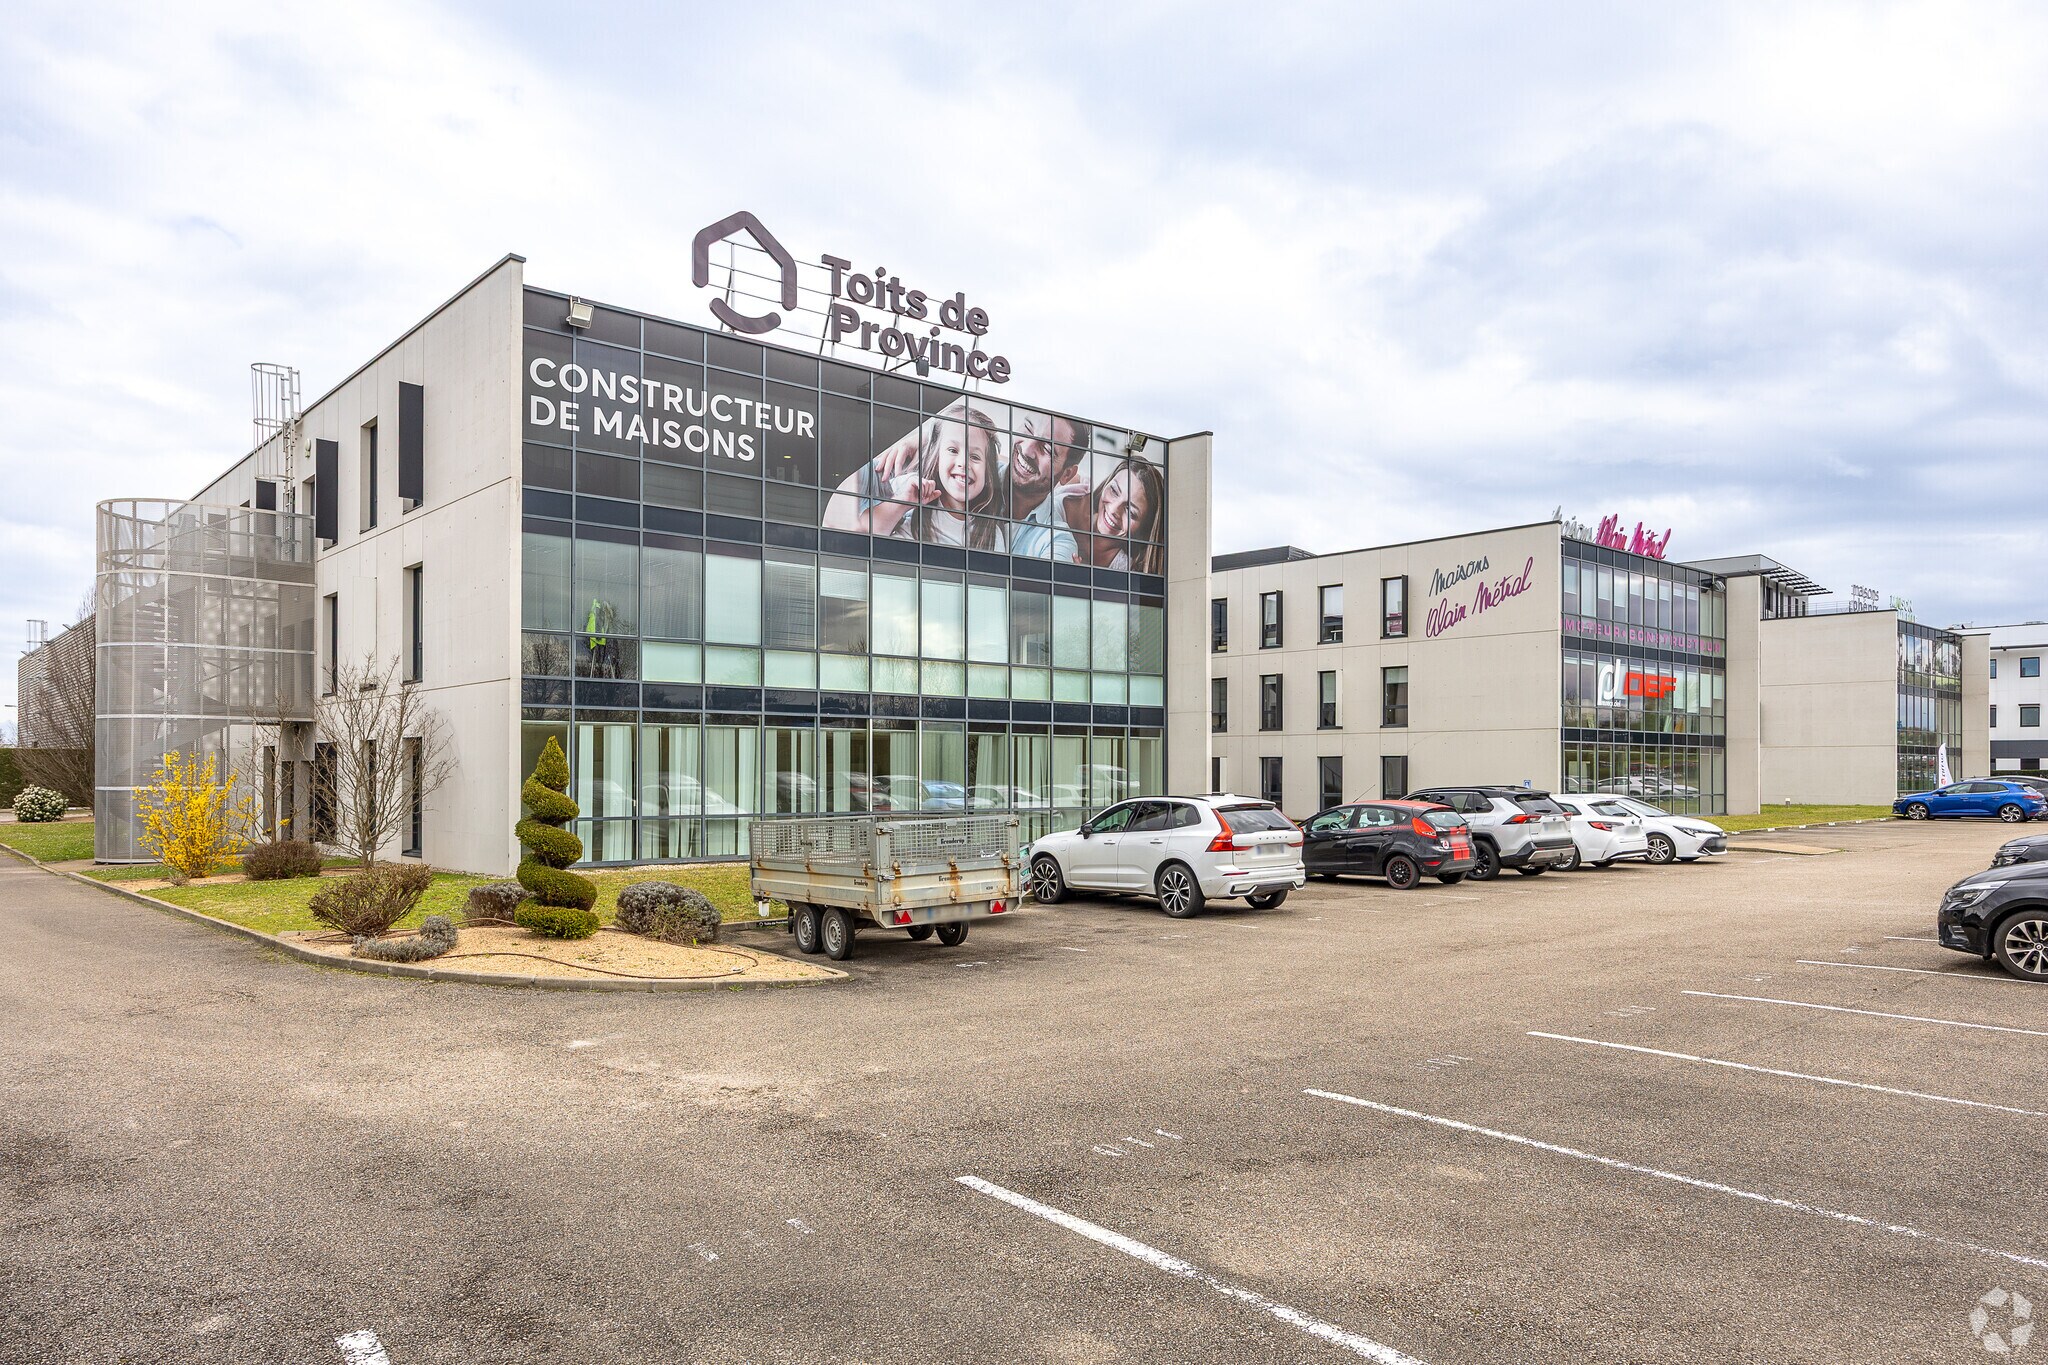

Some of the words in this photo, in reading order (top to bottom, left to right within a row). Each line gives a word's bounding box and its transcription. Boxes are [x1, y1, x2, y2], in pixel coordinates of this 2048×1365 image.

[821, 254, 928, 320] Toits
[940, 292, 989, 336] de
[832, 303, 1011, 384] Province
[529, 357, 816, 439] CONSTRUCTEUR
[530, 395, 580, 432] DE
[593, 406, 756, 462] MAISONS
[1426, 598, 1467, 638] Alain
[1472, 556, 1533, 615] Métral
[1428, 555, 1490, 597] Maisons
[1559, 616, 1620, 638] MOTEUR
[1623, 671, 1677, 699] DEF
